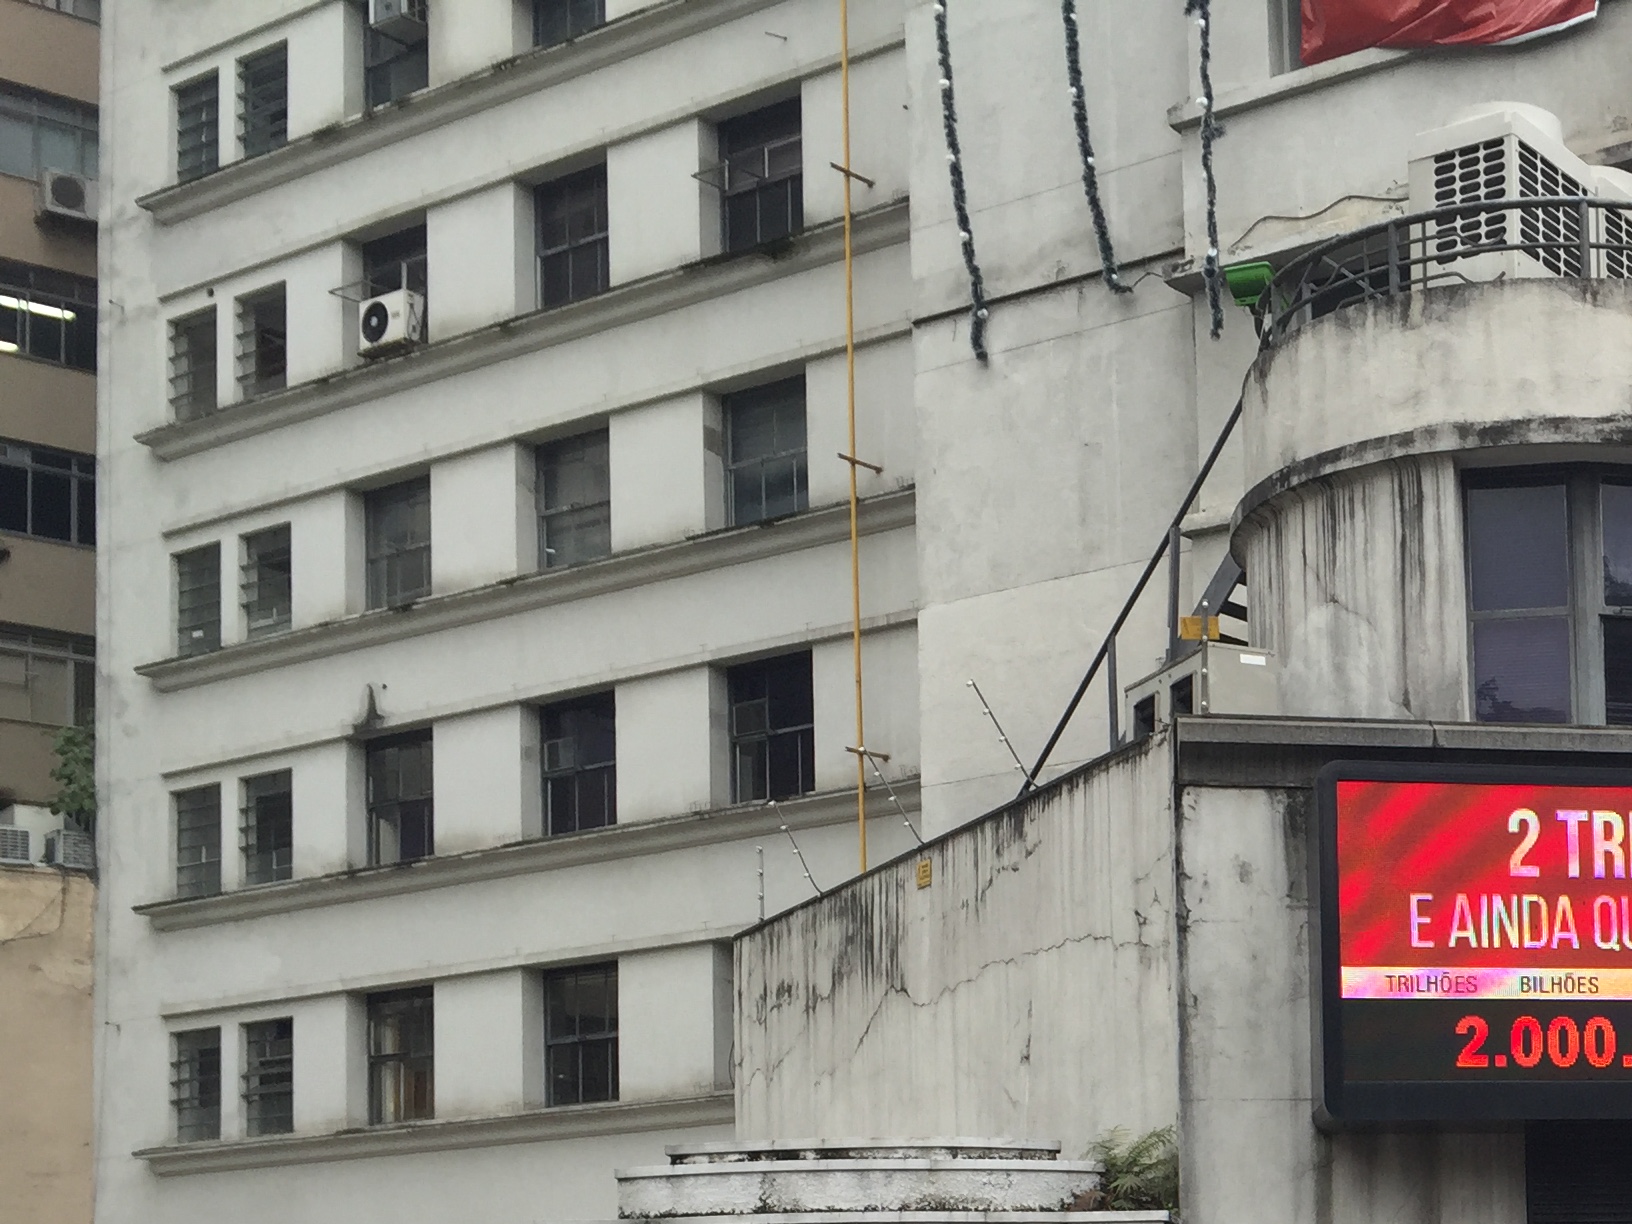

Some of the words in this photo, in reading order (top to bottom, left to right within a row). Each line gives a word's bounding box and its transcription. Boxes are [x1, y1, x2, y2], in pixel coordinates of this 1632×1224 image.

[1507, 808, 1542, 878] 2
[1409, 892, 1436, 949] E
[1447, 893, 1581, 950] AINDA
[1385, 972, 1479, 994] TRILHÕES
[1519, 972, 1600, 994] BILHÕES
